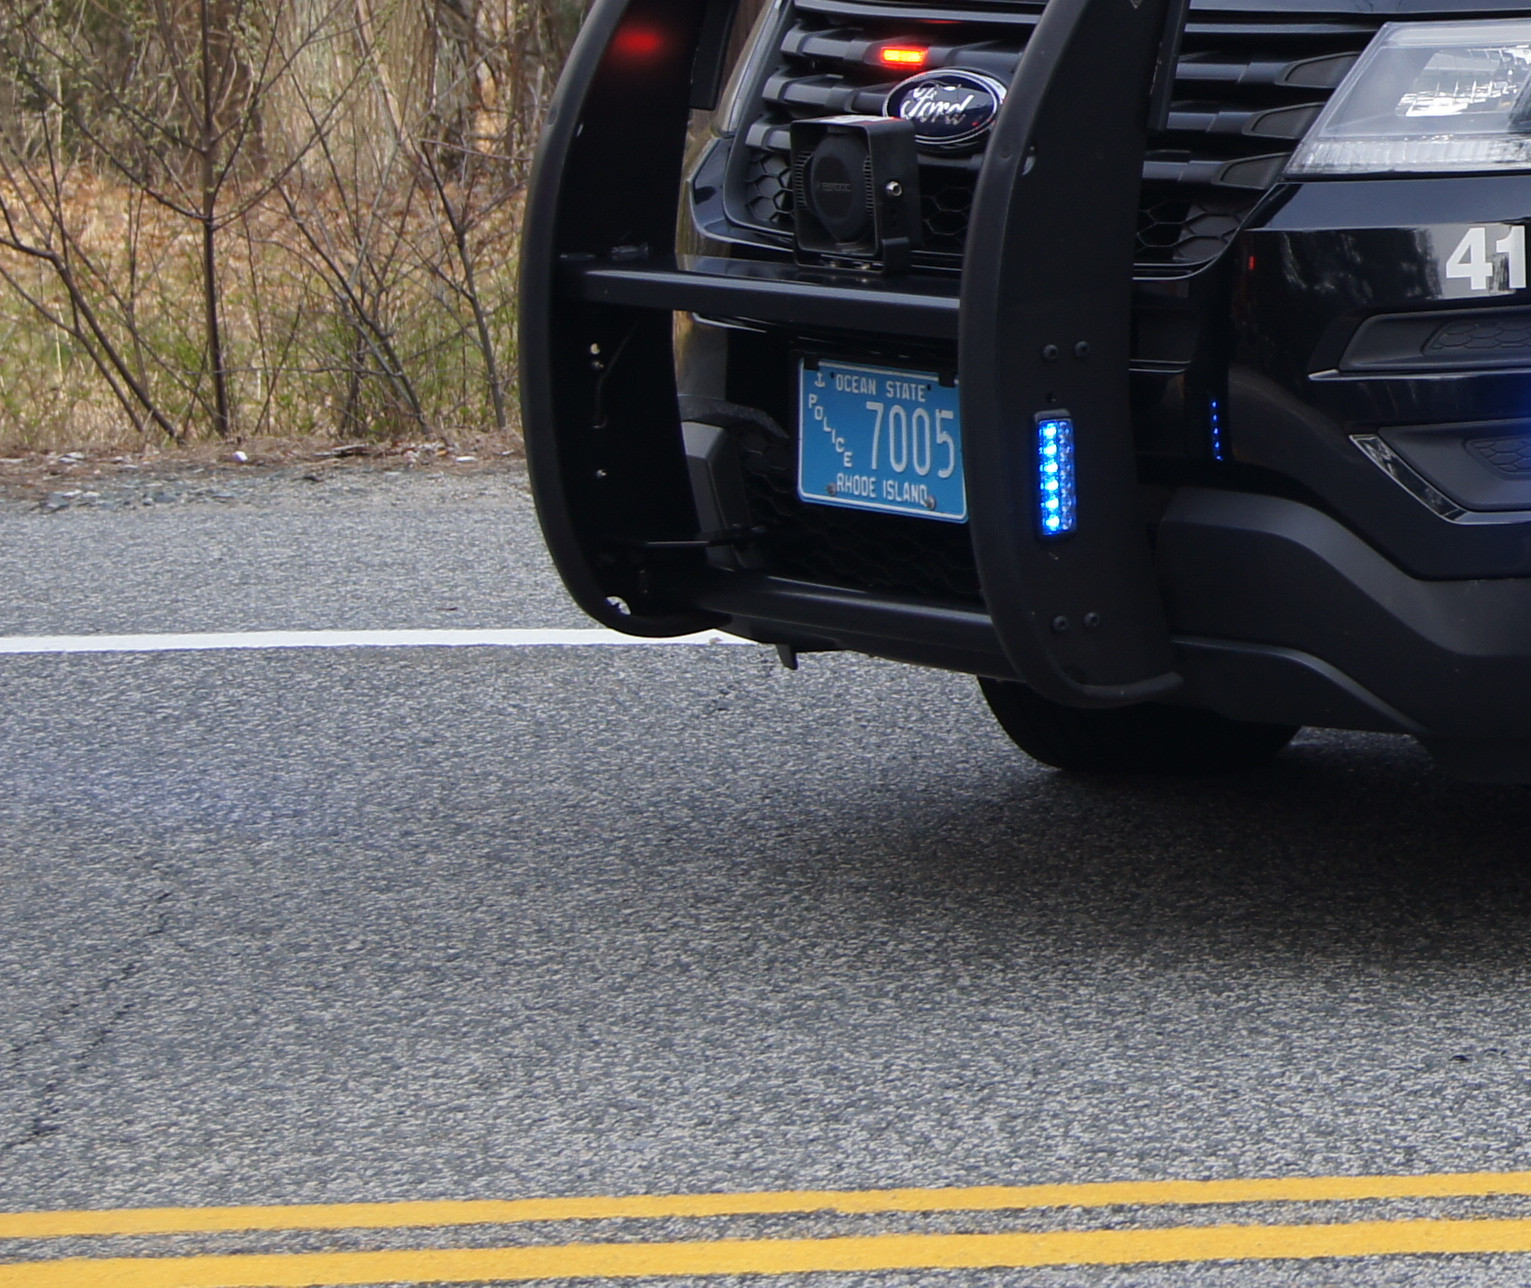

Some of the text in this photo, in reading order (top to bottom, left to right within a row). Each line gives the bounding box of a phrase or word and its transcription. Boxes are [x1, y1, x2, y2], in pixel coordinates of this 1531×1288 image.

[900, 83, 975, 125] Ford
[836, 373, 926, 402] OCEAN STATE
[808, 393, 853, 467] POLICE
[866, 401, 955, 478] 7005
[836, 473, 928, 506] RHODE ISLAND
